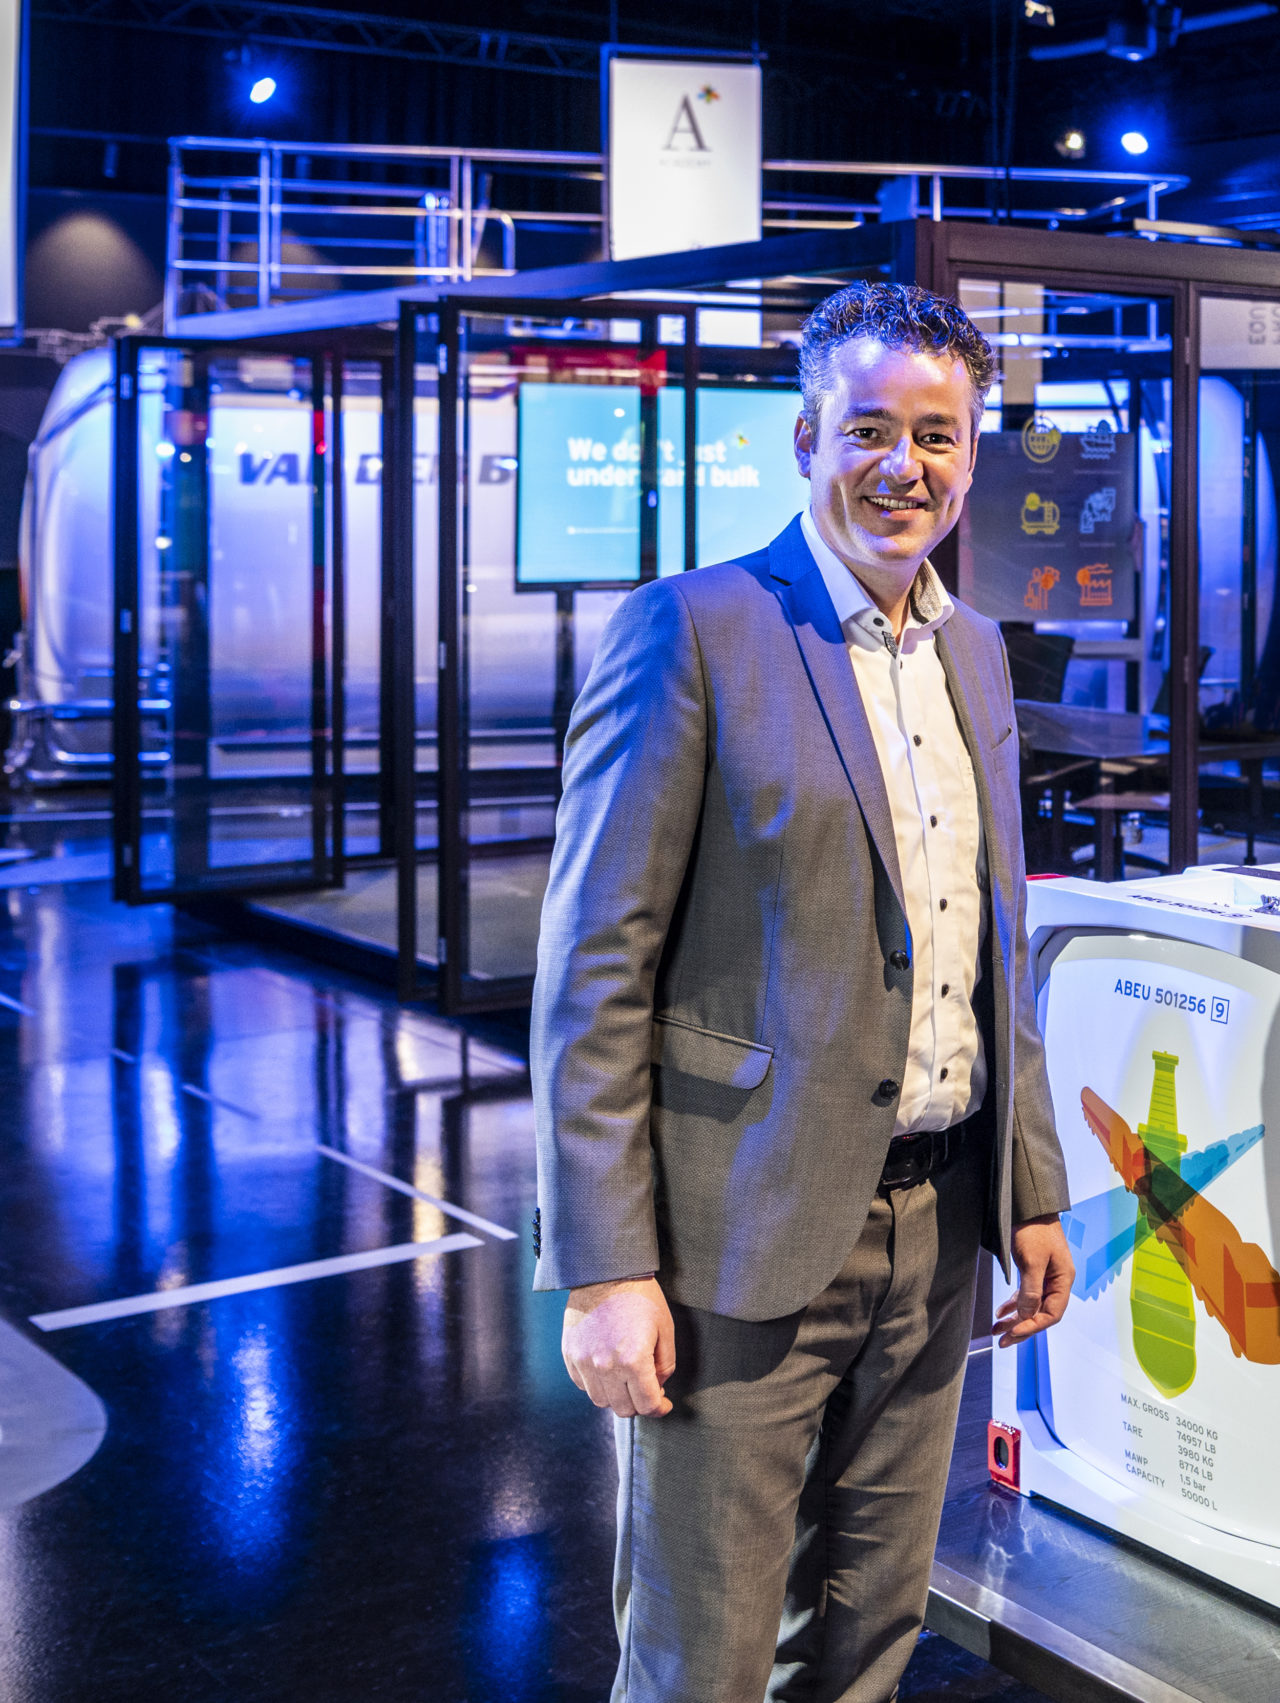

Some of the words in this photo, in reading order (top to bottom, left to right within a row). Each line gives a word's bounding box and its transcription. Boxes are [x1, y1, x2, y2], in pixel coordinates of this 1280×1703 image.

[661, 92, 713, 152] A
[567, 437, 607, 462] We
[710, 465, 761, 488] bulk
[1114, 978, 1151, 1001] ABEU
[1155, 988, 1206, 1014] 501256
[1120, 1393, 1140, 1409] MAX.
[1142, 1402, 1170, 1421] GROSS
[1176, 1416, 1204, 1435] 34000
[1206, 1429, 1218, 1440] KG
[1122, 1421, 1143, 1438] TARE
[1178, 1445, 1200, 1462] 3980
[1202, 1455, 1214, 1467] KG
[1176, 1430, 1202, 1448] 74957
[1205, 1442, 1216, 1454] LB
[1125, 1449, 1148, 1466] MAWP
[1180, 1474, 1191, 1486] 1,5
[1193, 1480, 1206, 1492] bar
[1126, 1463, 1165, 1487] CAPACITY
[1181, 1488, 1210, 1507] 50000
[1212, 1501, 1218, 1511] L
[1179, 1459, 1199, 1475] 8774
[1202, 1469, 1213, 1481] LB
